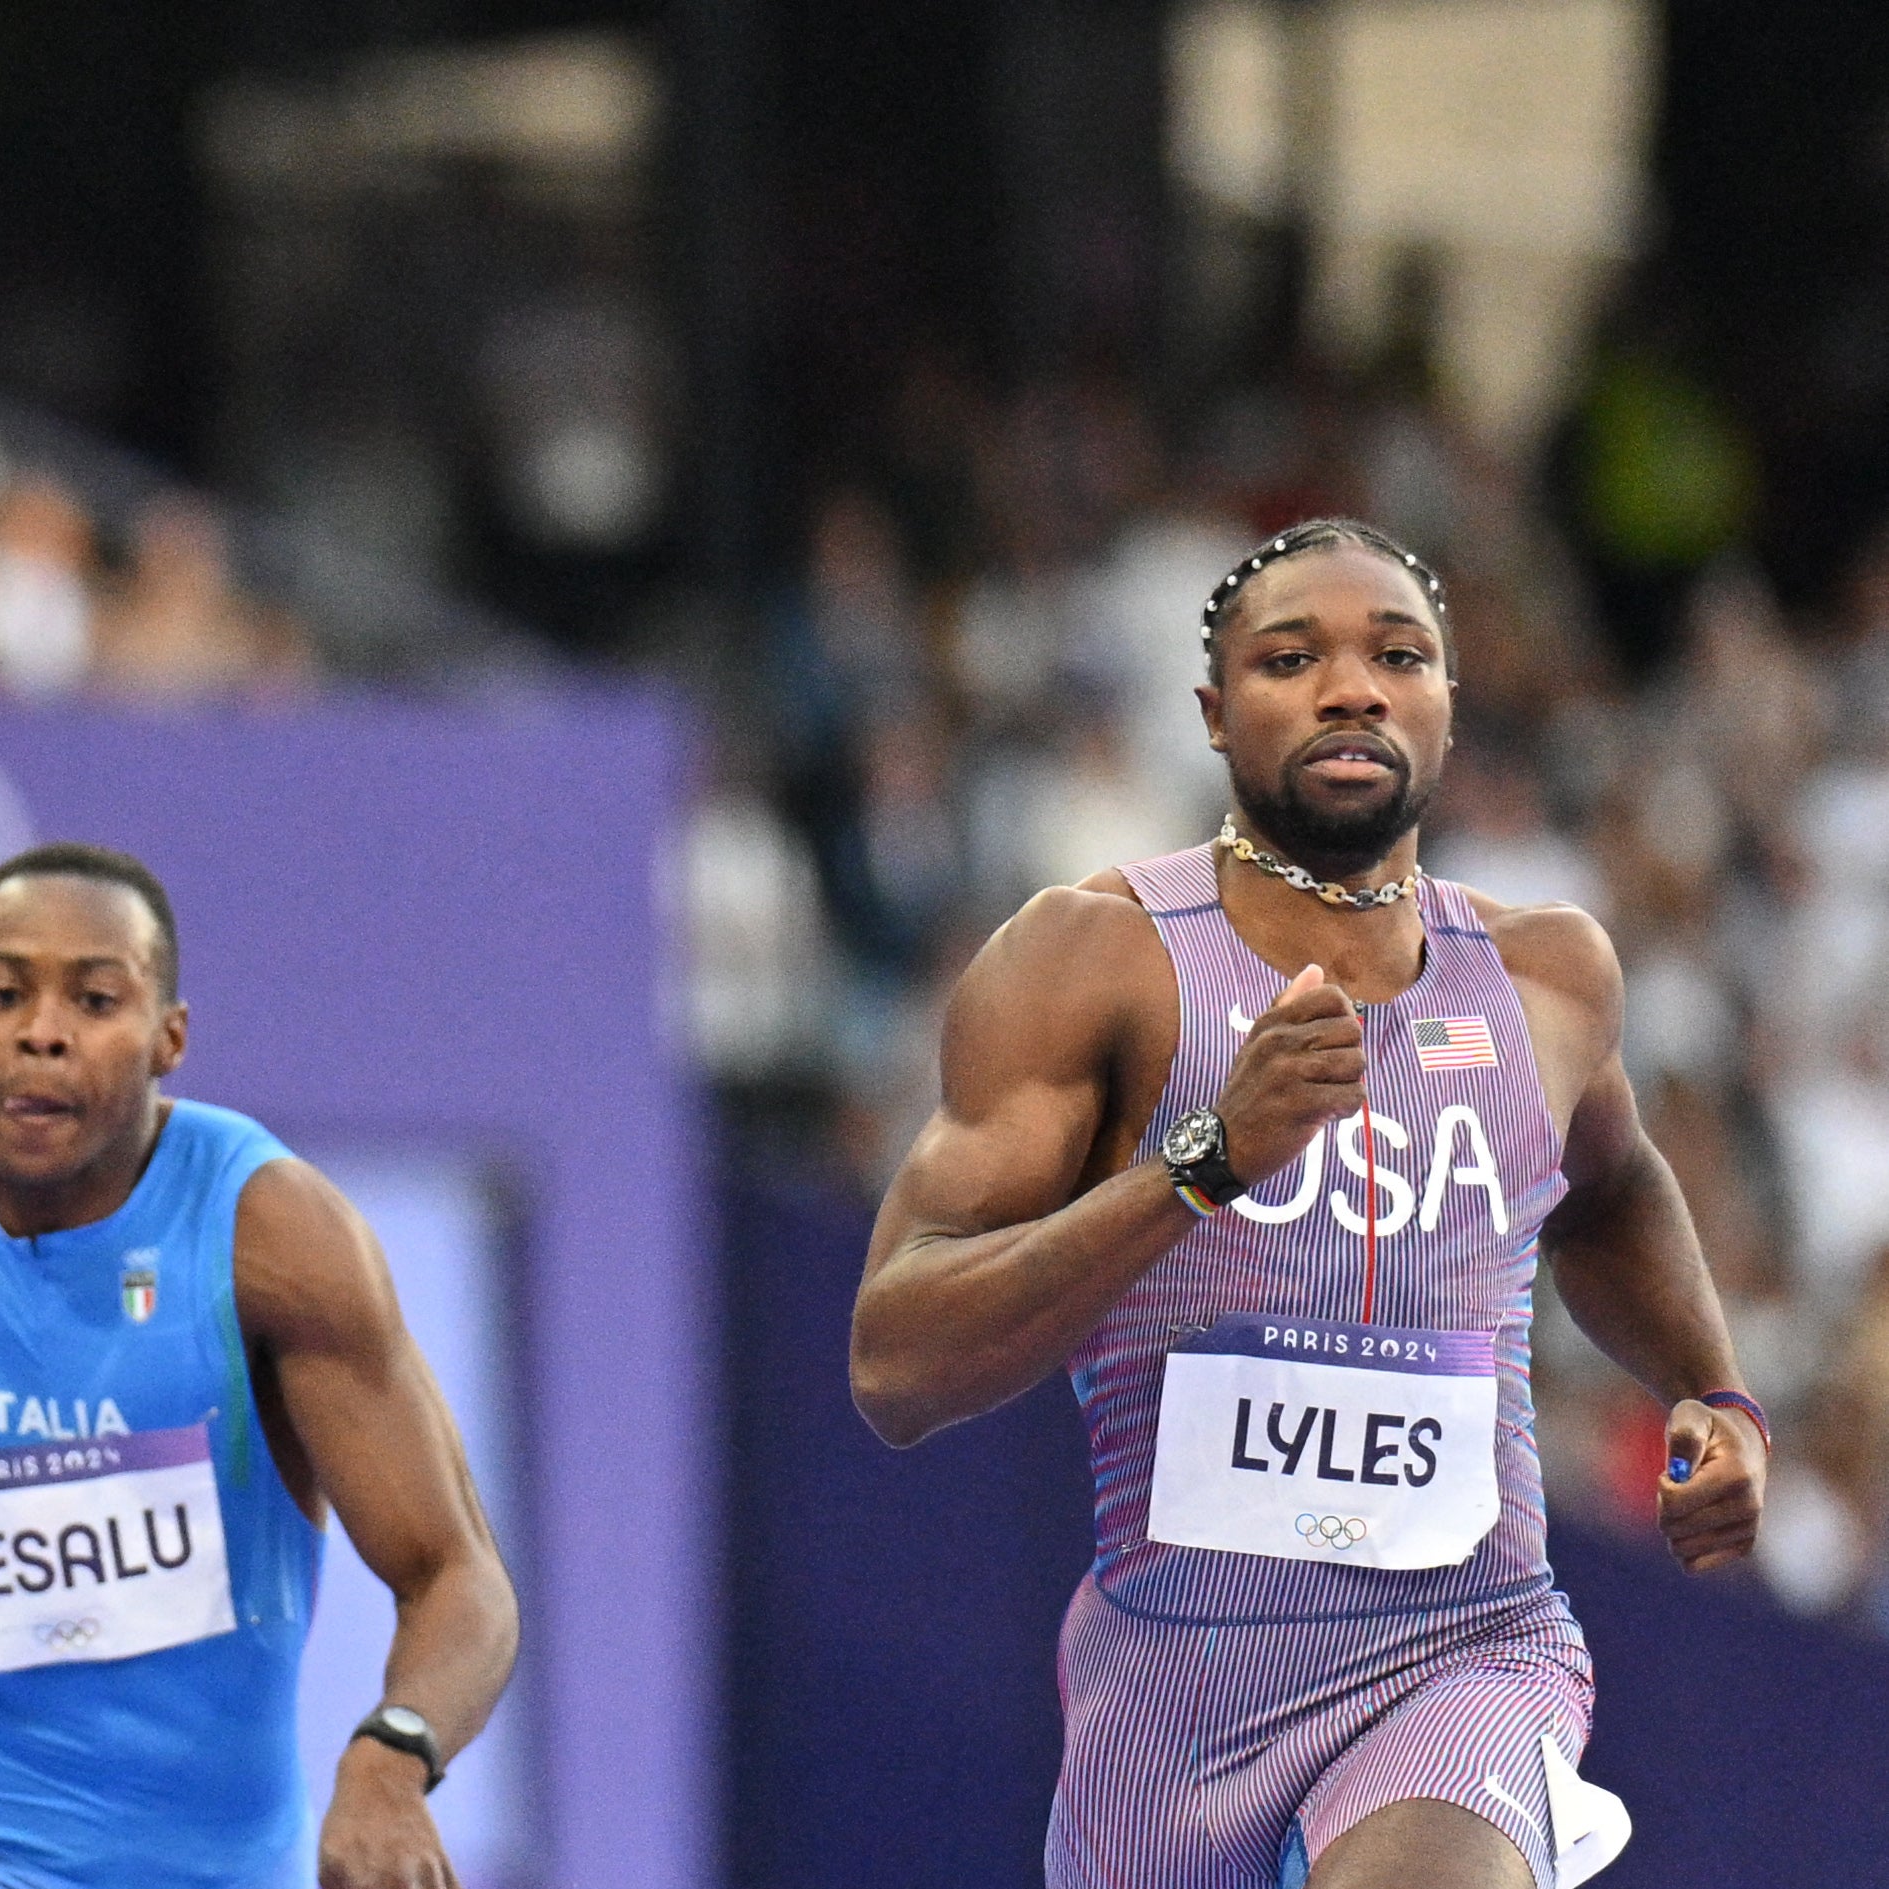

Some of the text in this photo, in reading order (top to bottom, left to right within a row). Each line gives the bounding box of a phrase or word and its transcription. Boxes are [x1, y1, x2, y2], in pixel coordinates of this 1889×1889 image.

[1229, 1103, 1510, 1238] USA
[1263, 1326, 1437, 1363] PARIS 2024
[45, 1446, 121, 1476] 2024
[1230, 1397, 1442, 1488] LYLES
